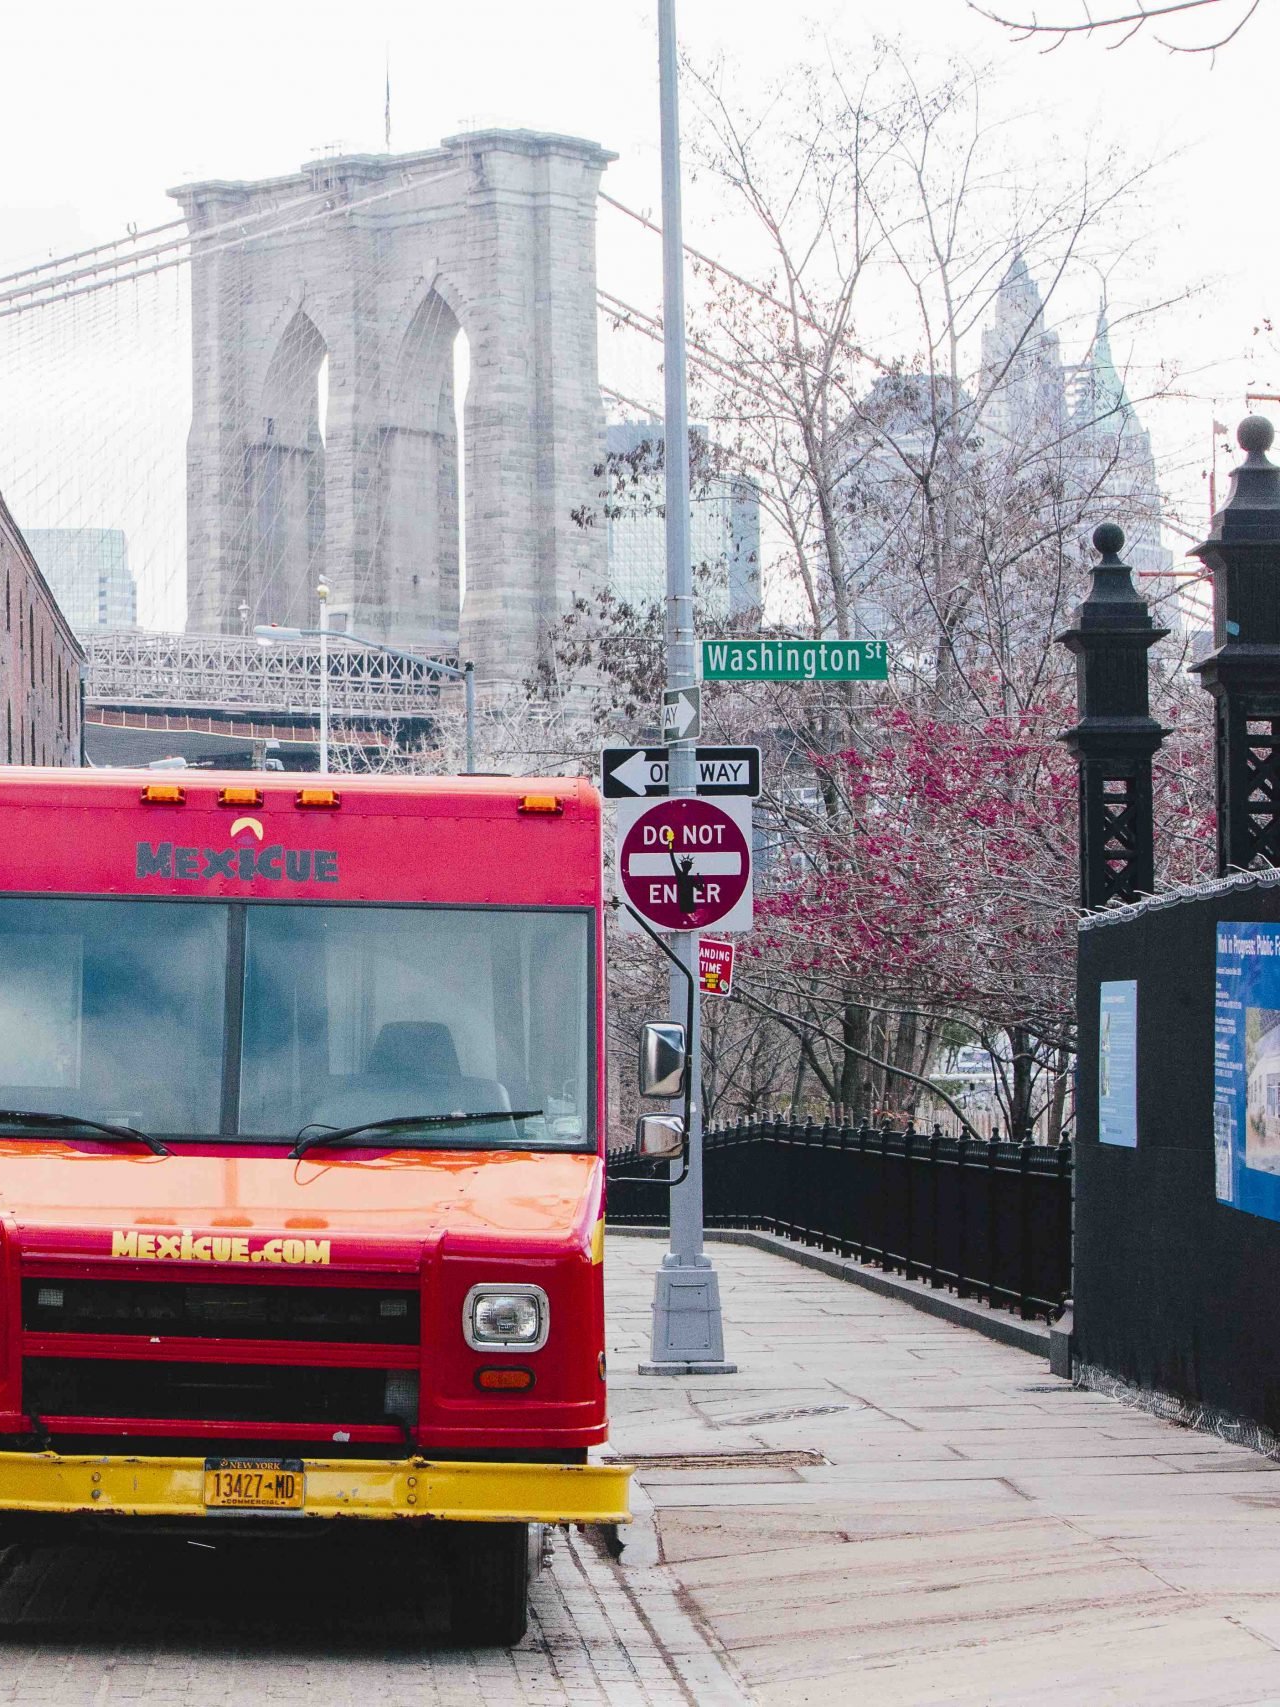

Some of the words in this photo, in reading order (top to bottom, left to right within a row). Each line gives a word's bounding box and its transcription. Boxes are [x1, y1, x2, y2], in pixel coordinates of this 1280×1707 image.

[707, 642, 860, 679] Washington
[865, 642, 882, 659] St
[663, 706, 677, 726] AY
[700, 763, 743, 782] WAY
[643, 825, 674, 845] DO
[683, 824, 725, 845] NOT
[649, 883, 721, 904] ENER
[229, 1461, 253, 1469] NEW
